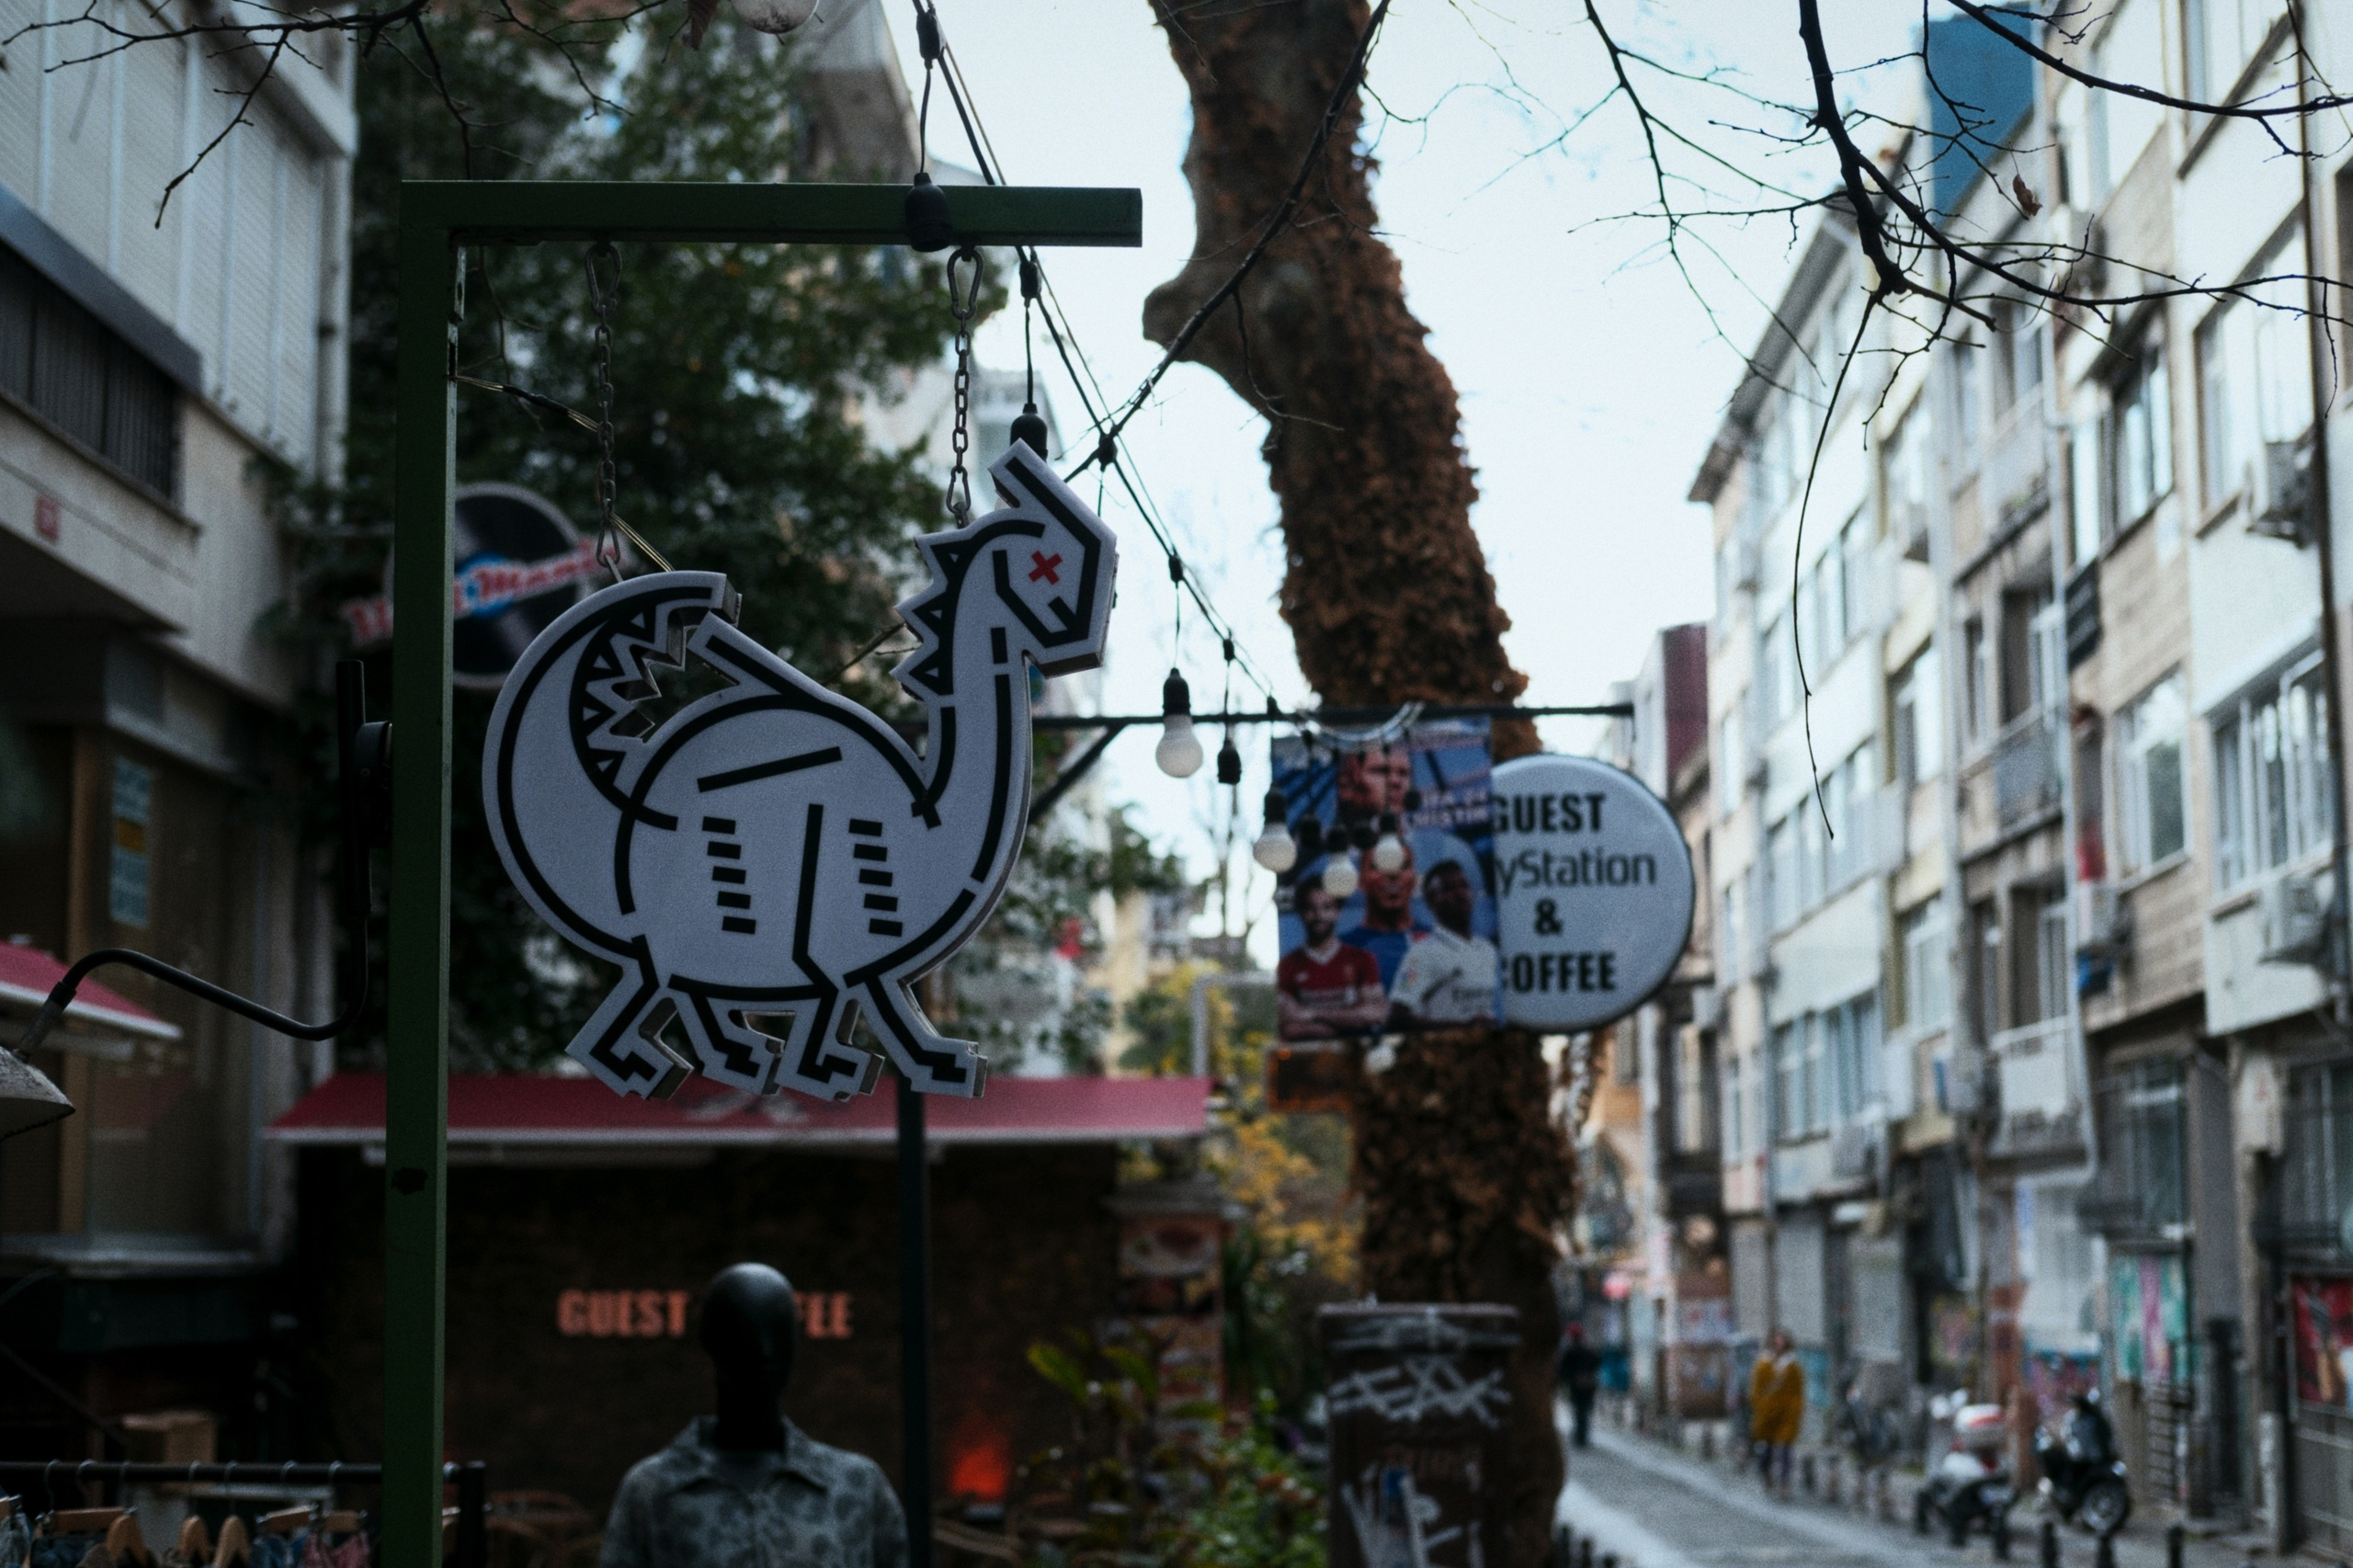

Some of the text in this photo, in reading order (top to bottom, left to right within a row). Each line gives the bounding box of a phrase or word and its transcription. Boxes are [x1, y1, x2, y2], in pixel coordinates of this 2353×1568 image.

[1492, 794, 1606, 834] GUEST
[1494, 846, 1656, 898] yStation
[1534, 898, 1562, 936] &
[556, 1289, 690, 1339] GUEST
